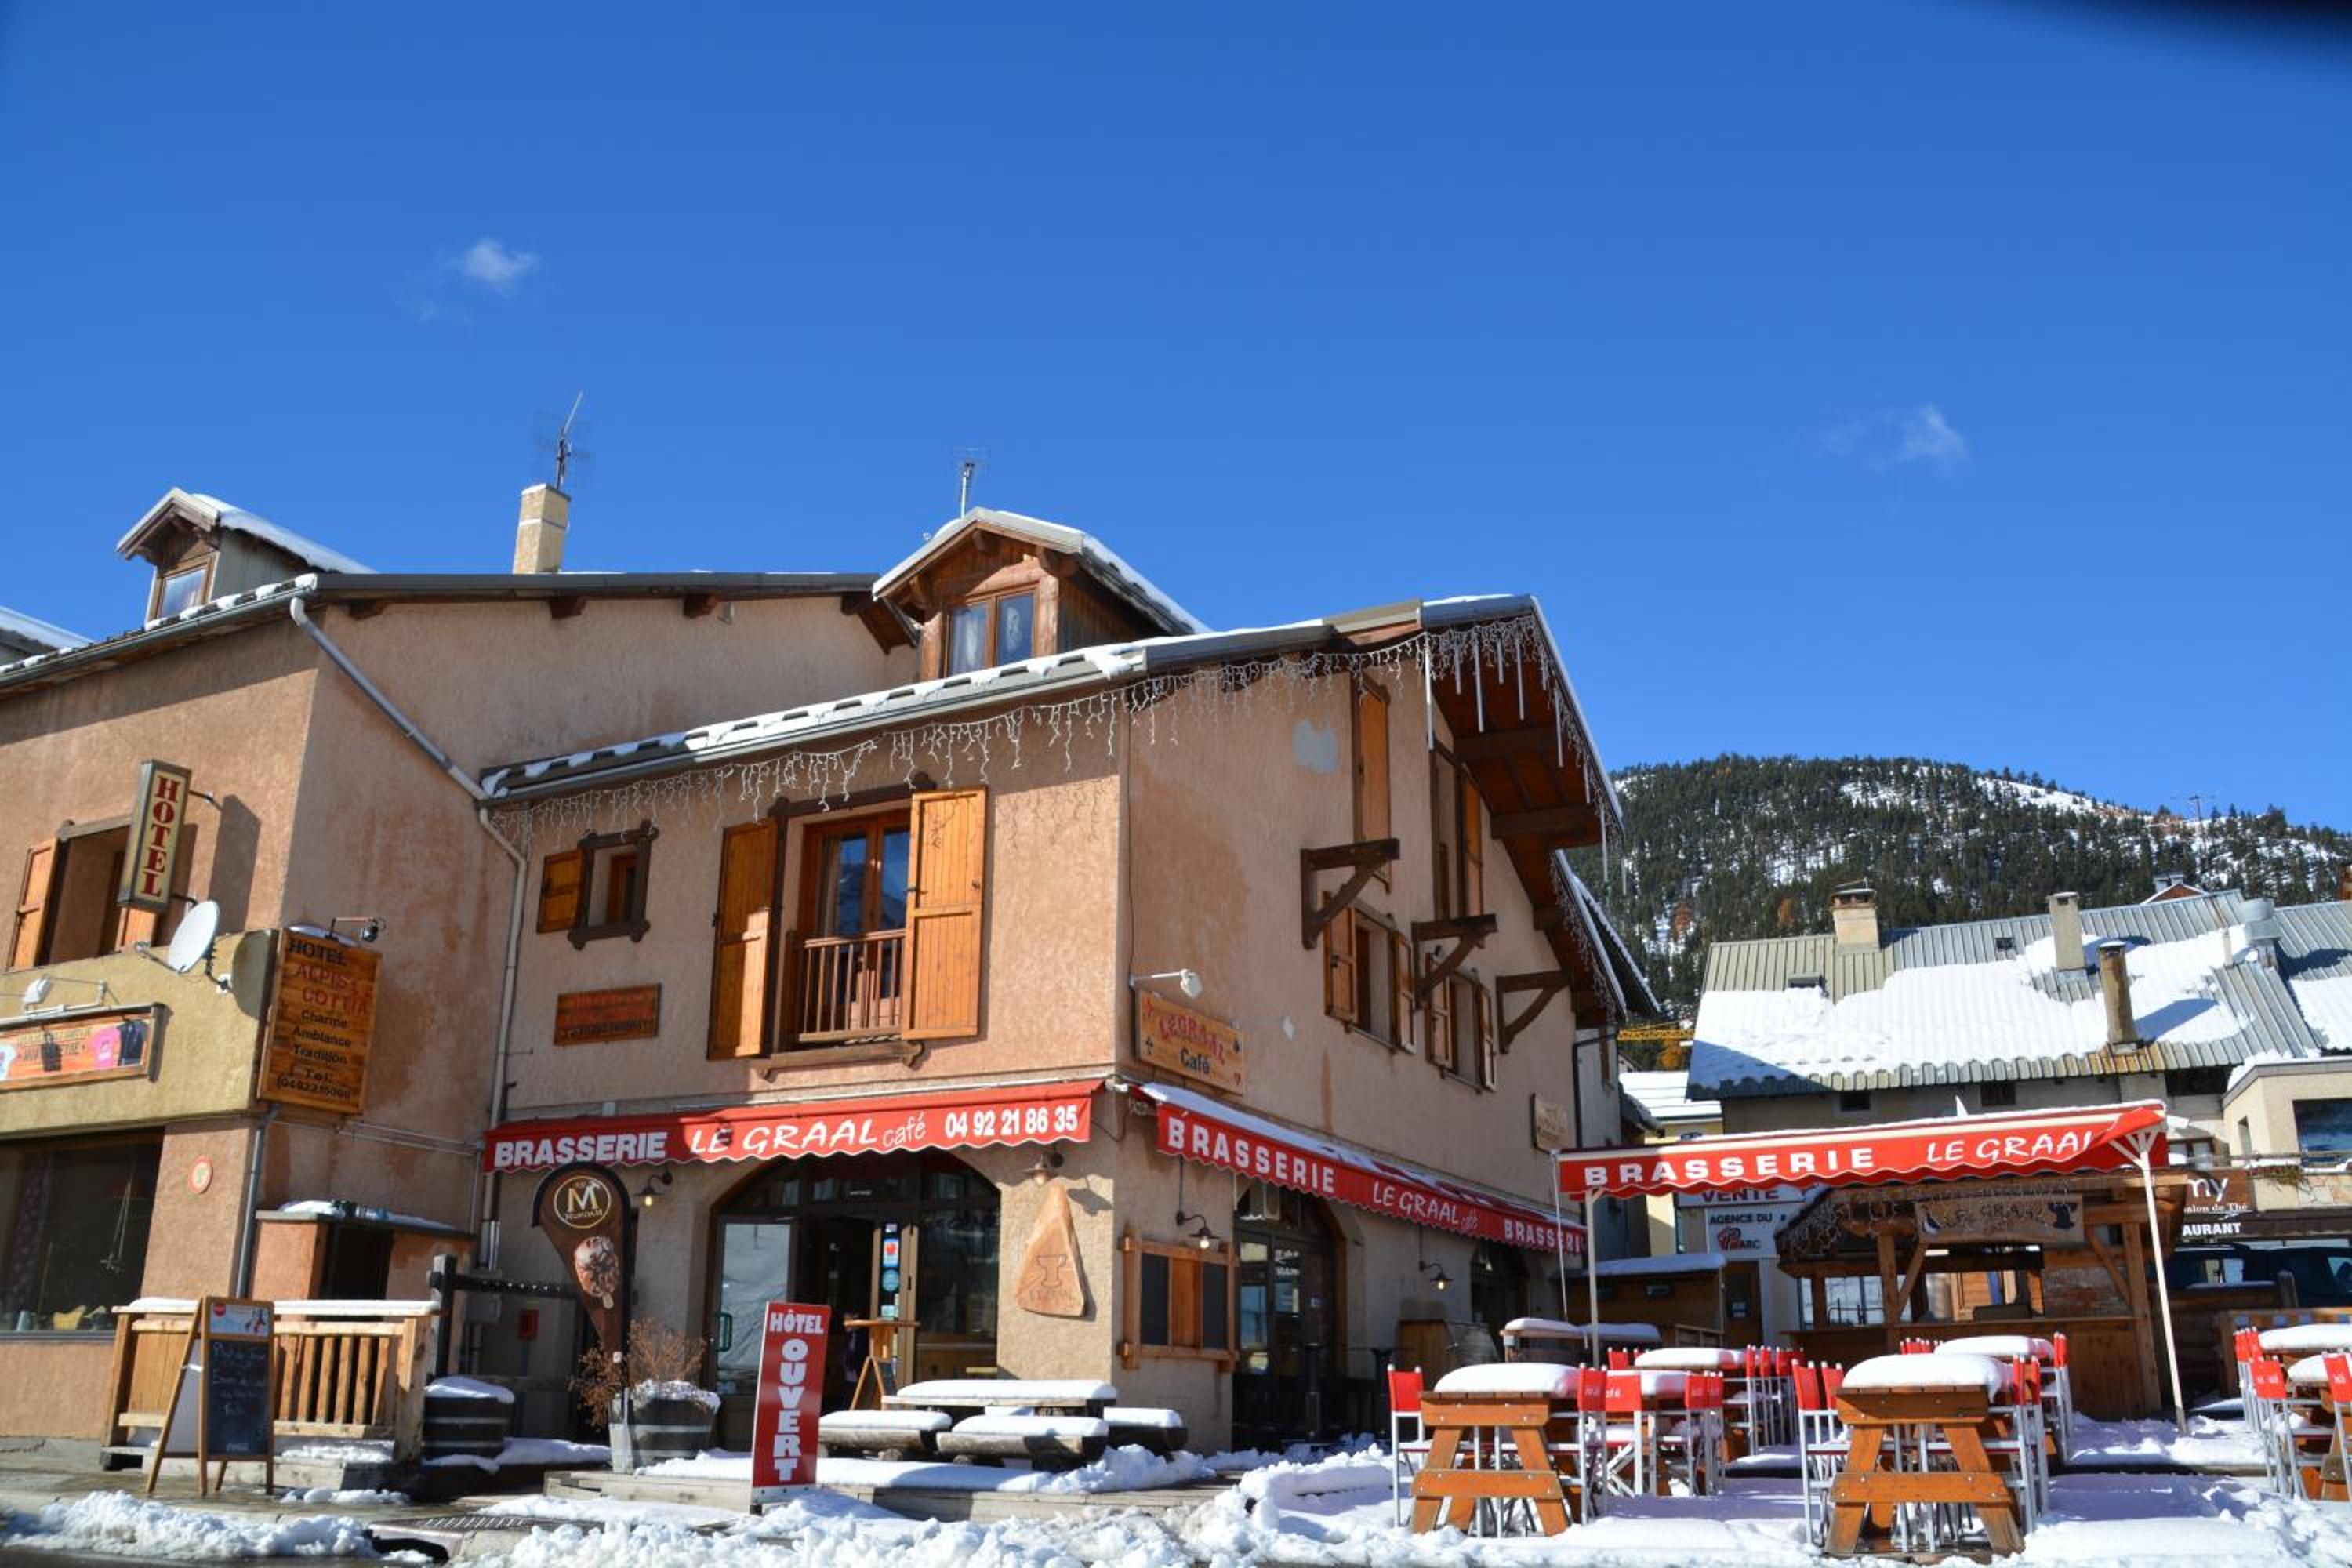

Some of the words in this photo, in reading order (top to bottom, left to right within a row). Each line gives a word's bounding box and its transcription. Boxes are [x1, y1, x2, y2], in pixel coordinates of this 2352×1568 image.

[140, 775, 181, 897] HOTEL
[289, 940, 347, 966] HOTEL
[300, 1009, 347, 1029] Charme
[292, 1026, 352, 1047] Ambiance
[292, 1044, 347, 1065] Tradition
[493, 1131, 668, 1167] BRASSERIE
[690, 1124, 733, 1155] LE
[742, 1119, 878, 1154] GRAAL
[882, 1111, 927, 1148] café
[945, 1112, 968, 1138] 04
[973, 1110, 996, 1136] 92
[1001, 1108, 1020, 1135] 21
[1025, 1106, 1049, 1134] 86
[1054, 1105, 1078, 1131] 35
[1167, 1116, 1334, 1192] BRASSERIE
[1373, 1181, 1396, 1207] LE
[1399, 1191, 1459, 1225] GRAAL
[1584, 1147, 1874, 1187] BRASSERIE
[1926, 1141, 1965, 1163] LE
[1710, 1214, 1754, 1225] AGENCE
[1756, 1213, 1773, 1222] DU
[2183, 1205, 2209, 1214] alon
[2182, 1223, 2241, 1236] AURANT
[769, 1308, 824, 1334] HÔTEL
[1606, 1388, 1622, 1399] afé
[773, 1338, 808, 1481] OUVERT
